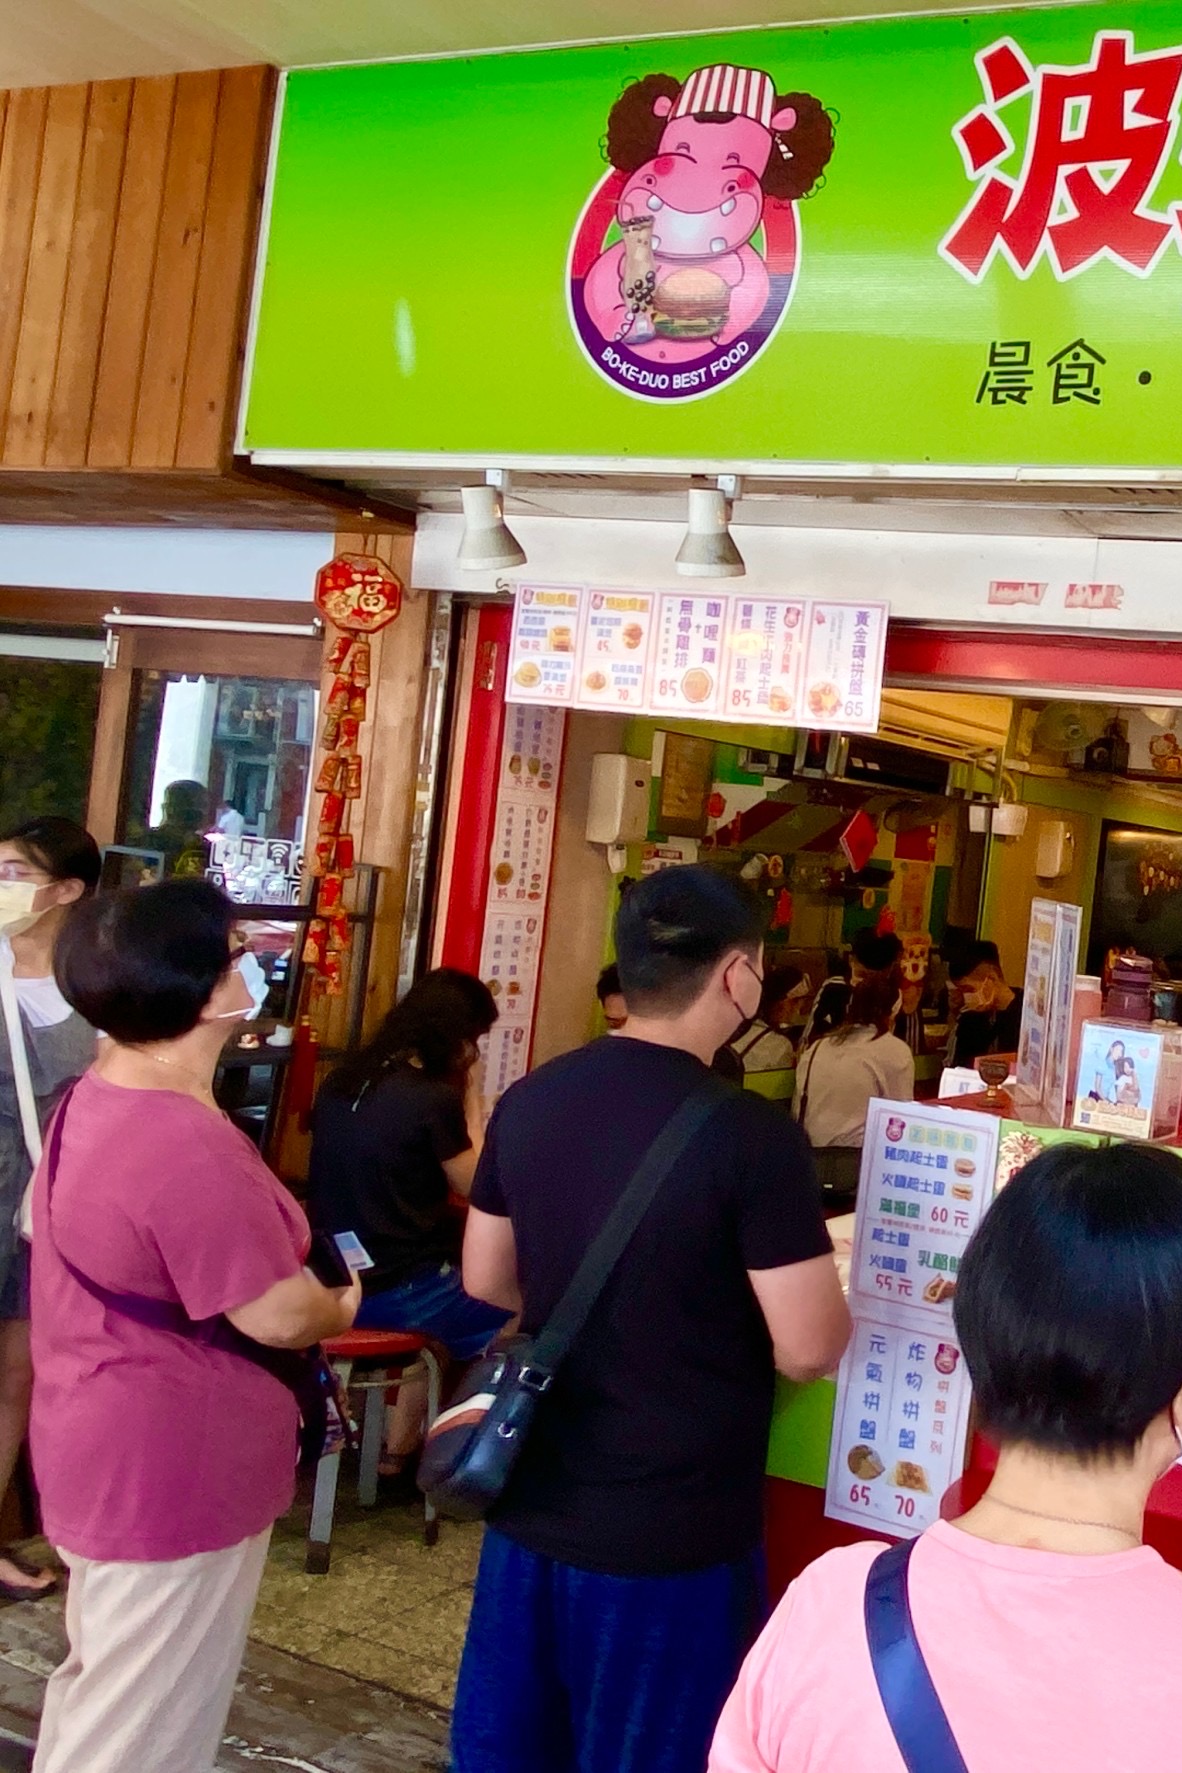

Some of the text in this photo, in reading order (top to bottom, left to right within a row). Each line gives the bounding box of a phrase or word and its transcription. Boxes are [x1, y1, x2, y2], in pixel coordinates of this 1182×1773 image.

[601, 341, 750, 389] BO-KE-DUO BEST FOOD
[659, 679, 678, 697] 85
[732, 689, 752, 707] 85
[844, 701, 864, 717] 65
[859, 1334, 887, 1441] 元氣拼盤
[899, 1341, 927, 1450] 炸物拼盤
[850, 1484, 871, 1506] 65
[895, 1495, 915, 1517] 70
